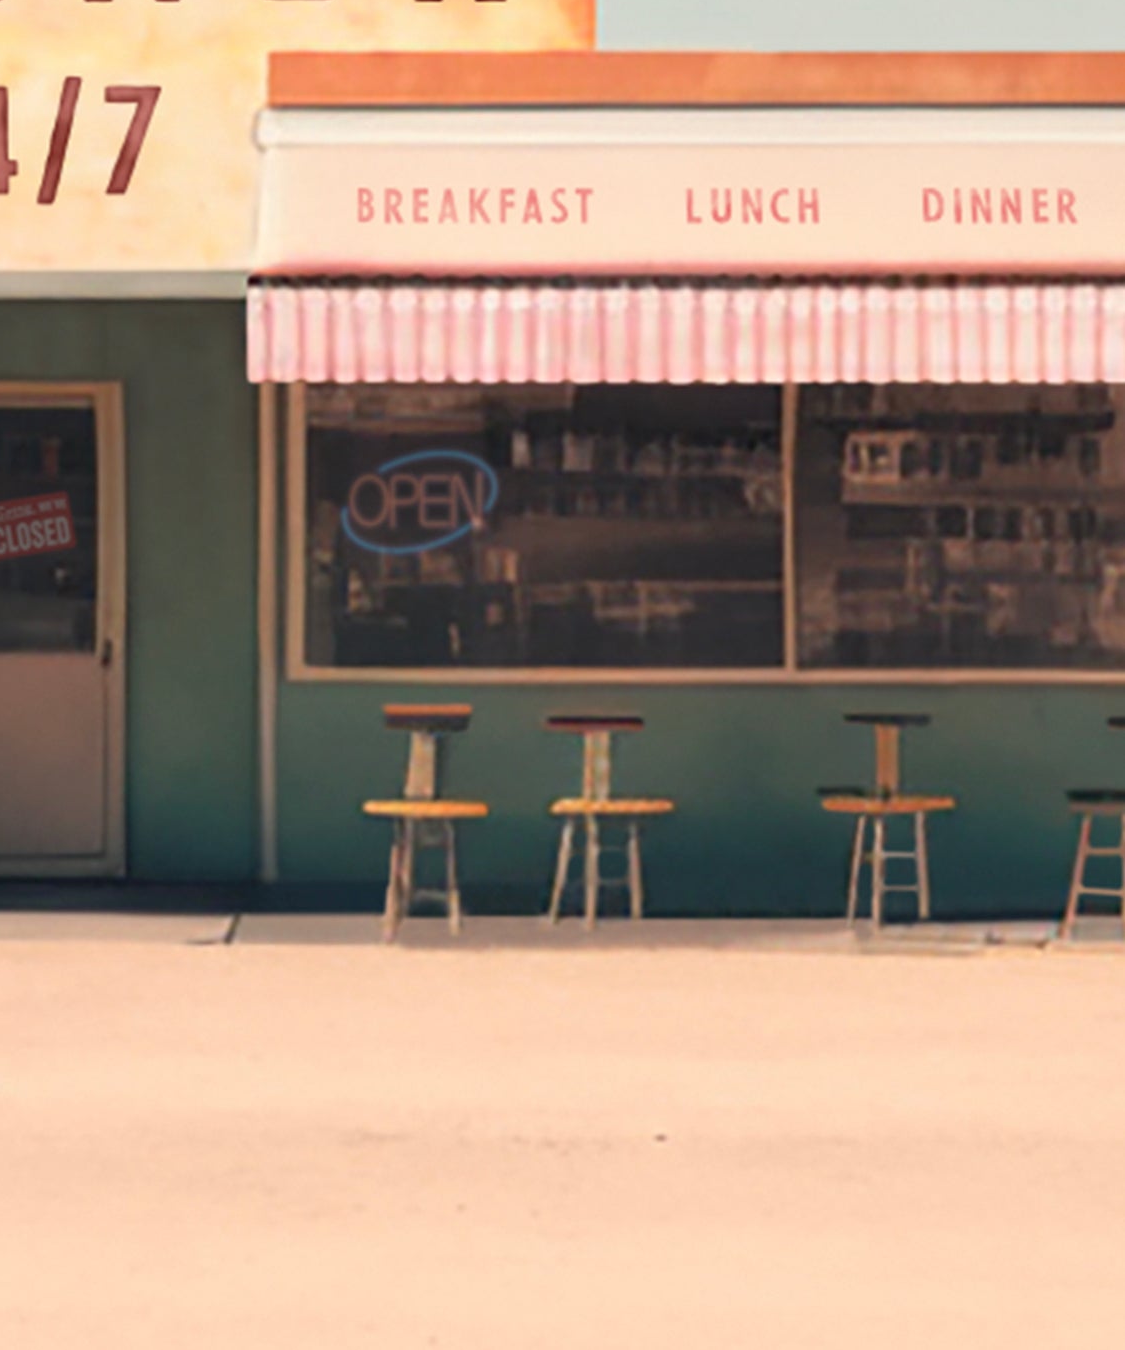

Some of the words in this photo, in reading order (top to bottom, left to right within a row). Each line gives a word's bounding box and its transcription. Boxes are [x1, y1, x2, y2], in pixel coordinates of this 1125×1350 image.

[356, 187, 594, 225] BREAKFAST
[684, 187, 821, 225] LUNCH
[920, 187, 1079, 225] DINNER
[348, 471, 484, 530] OPEN
